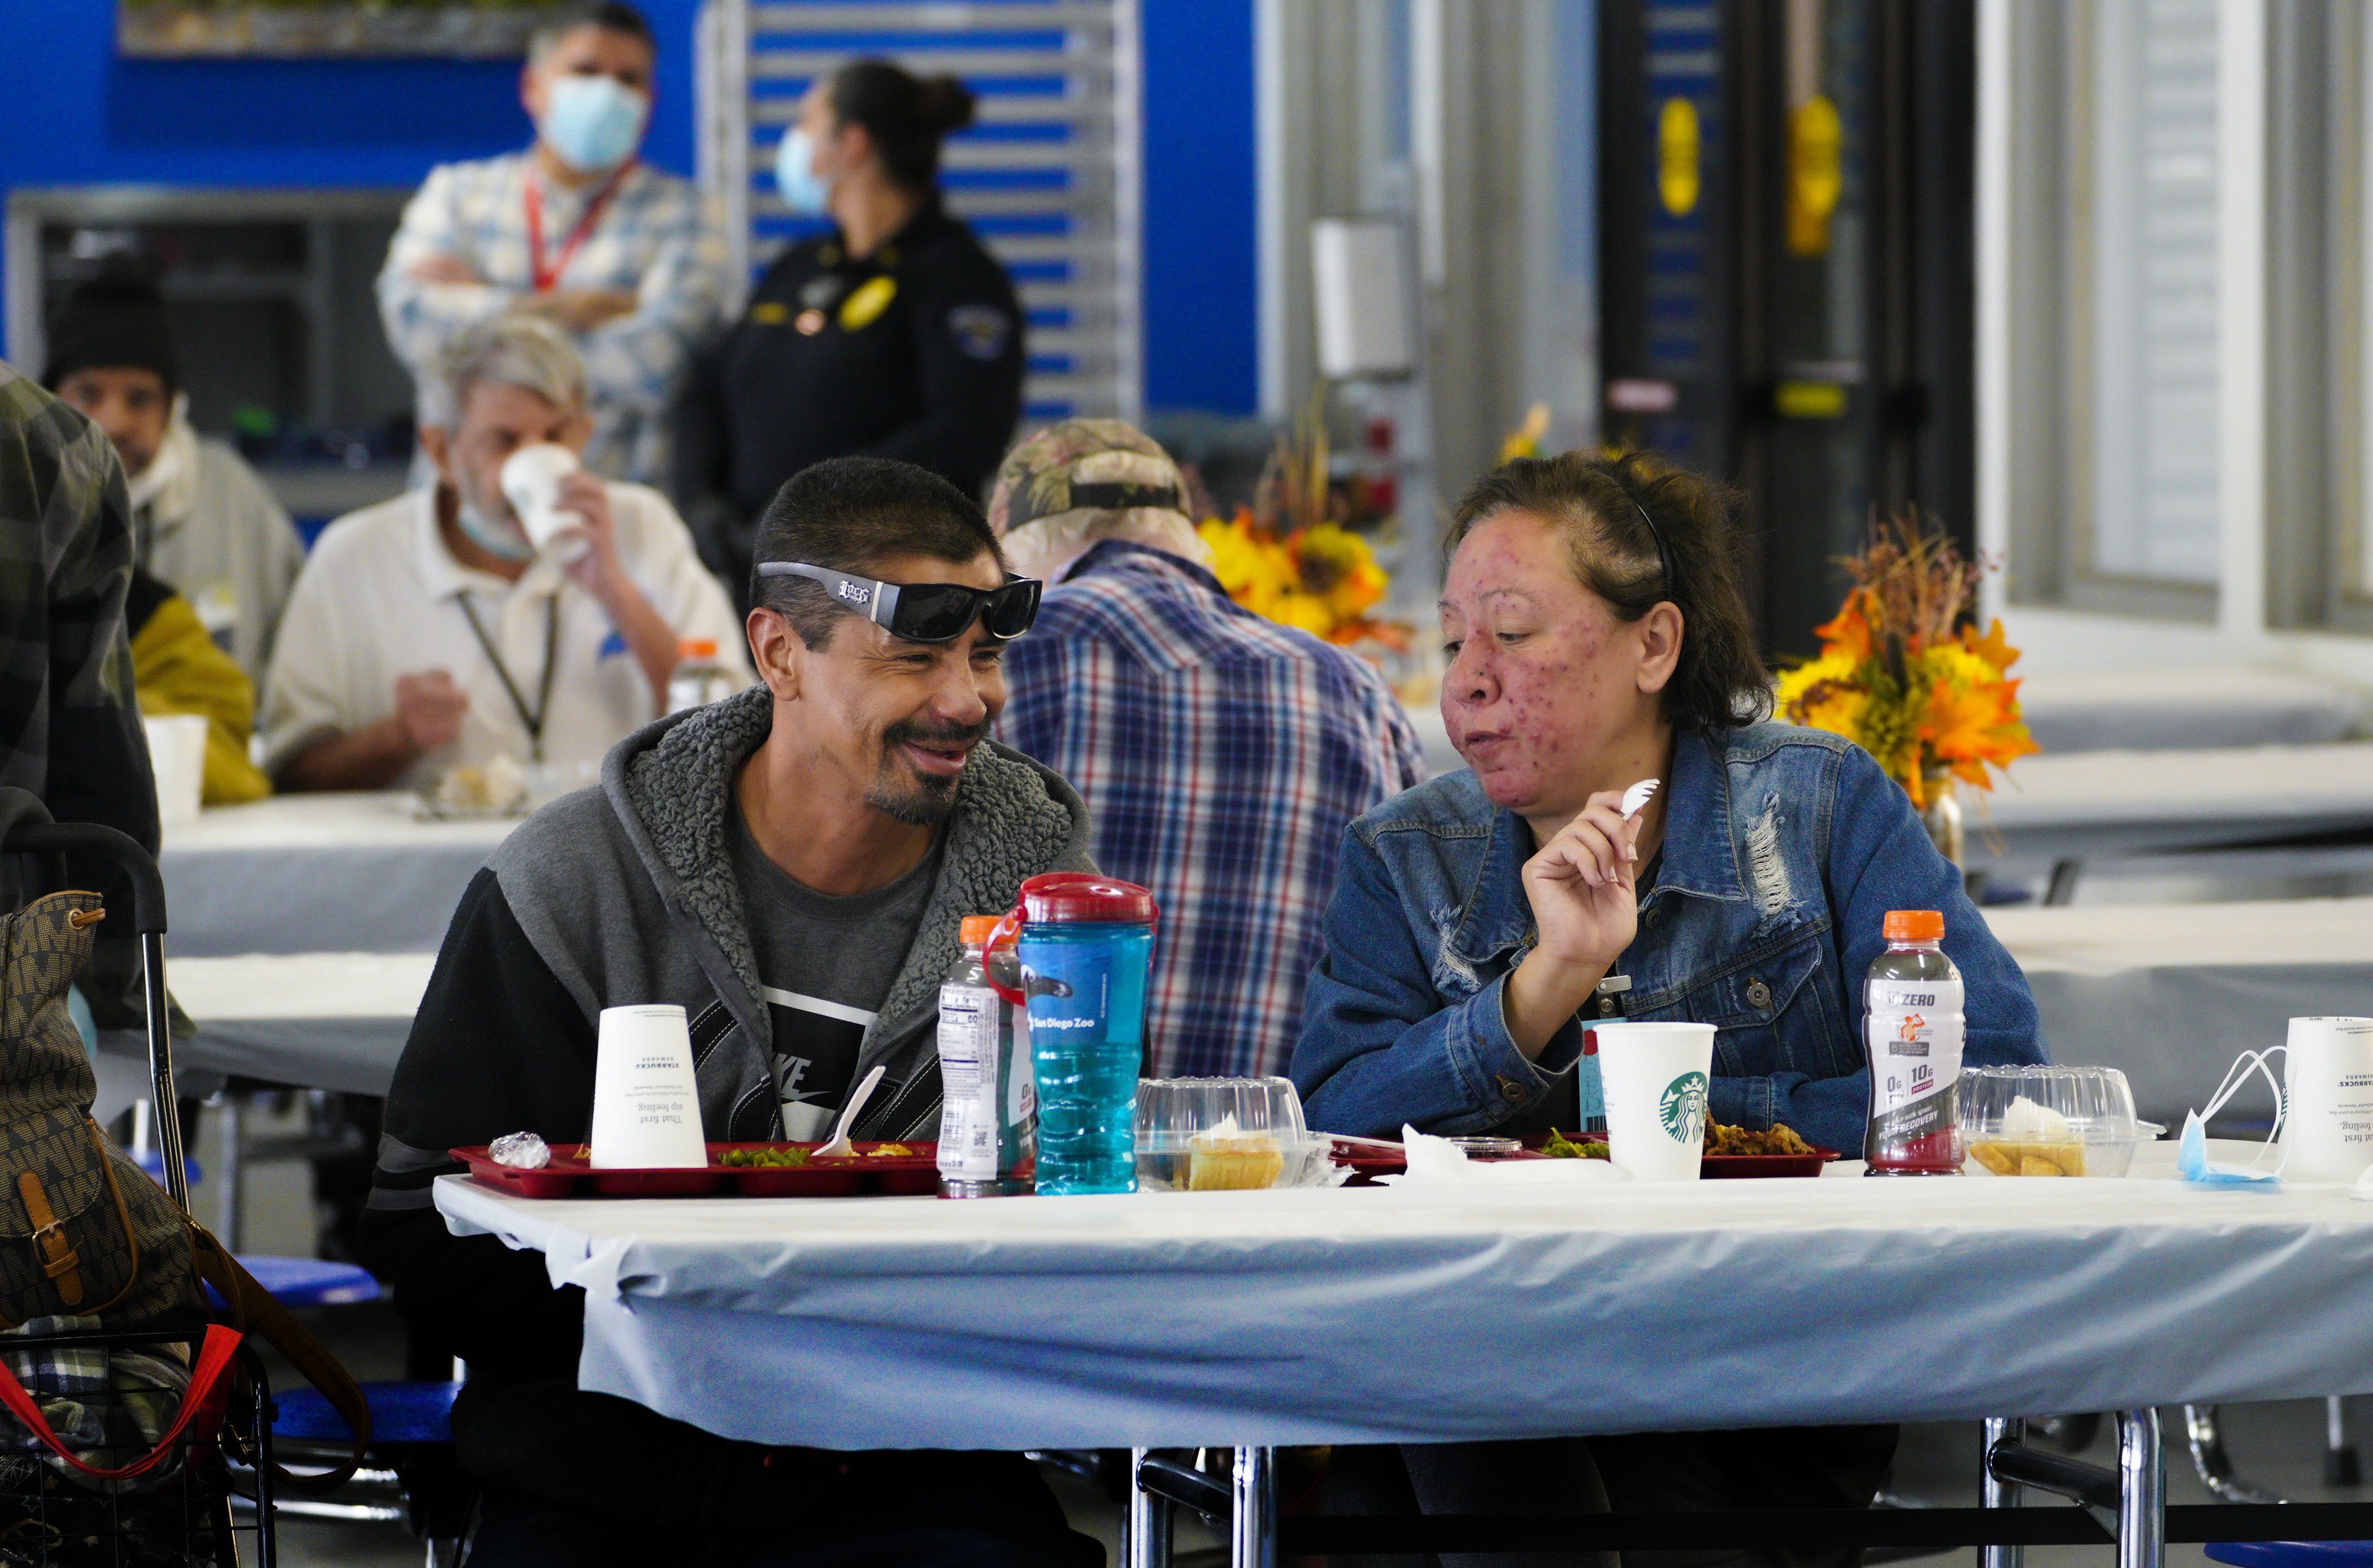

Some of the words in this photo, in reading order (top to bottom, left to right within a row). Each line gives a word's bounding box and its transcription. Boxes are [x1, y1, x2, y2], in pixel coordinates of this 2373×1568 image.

[1900, 994, 1936, 1006] ZERO
[1034, 1017, 1046, 1028] San
[1047, 1017, 1072, 1030] Diego
[1074, 1018, 1094, 1028] Zoo
[772, 1053, 812, 1095] KE
[1887, 1076, 1902, 1092] 0G
[1911, 1064, 1933, 1083] 10G
[1913, 1079, 1933, 1094] PROTEIN
[636, 1103, 669, 1112] feeling.
[671, 1102, 683, 1111] sip
[1905, 1112, 1916, 1120] KICK
[1918, 1105, 1933, 1116] START
[640, 1115, 659, 1124] first
[662, 1115, 682, 1124] That
[1879, 1128, 1898, 1141] YOUR
[1900, 1110, 1939, 1133] RECOVERY
[2340, 1121, 2371, 1131] feeling.
[2344, 1134, 2362, 1143] first
